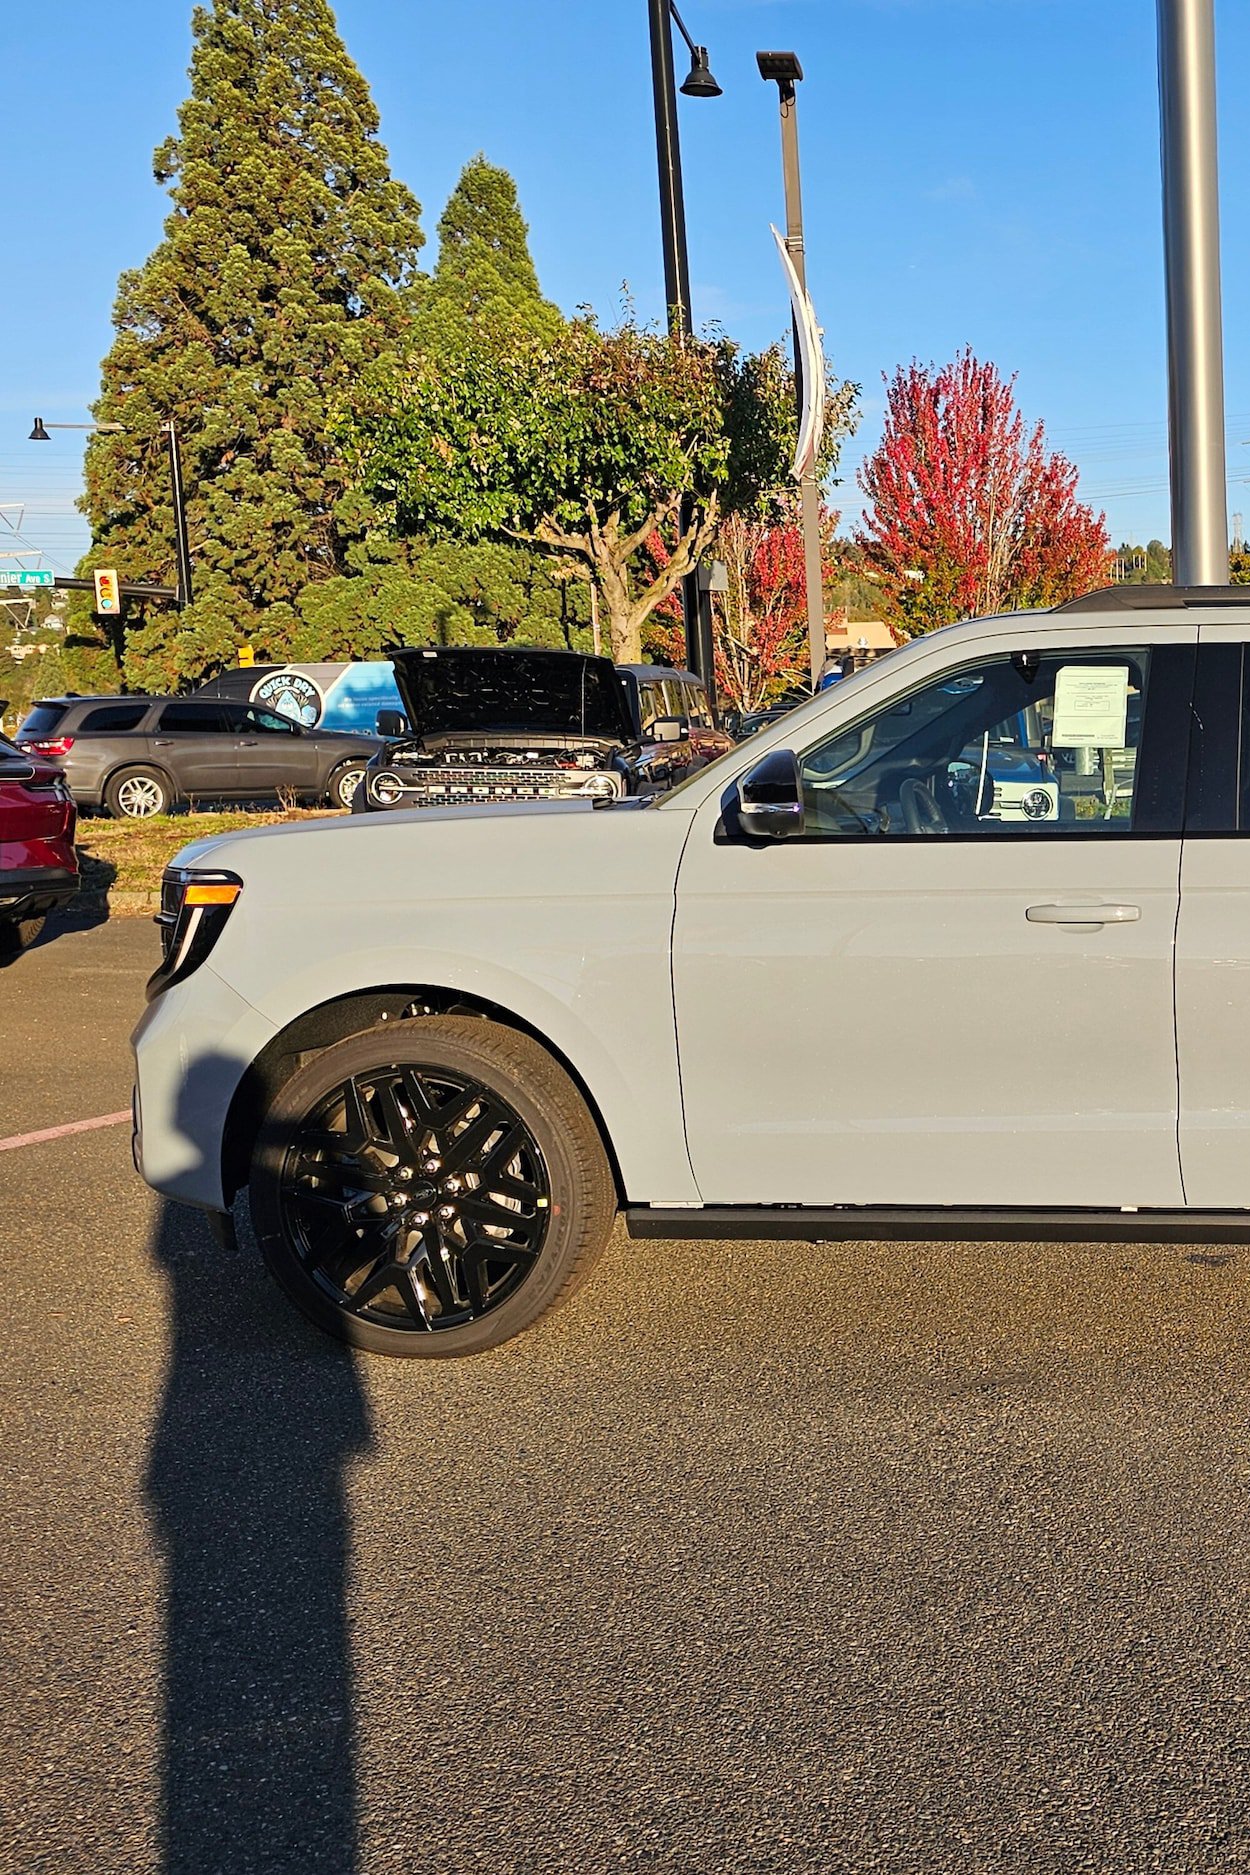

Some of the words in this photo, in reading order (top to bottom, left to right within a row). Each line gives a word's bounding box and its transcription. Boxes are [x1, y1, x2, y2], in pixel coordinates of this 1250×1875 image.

[25, 574, 41, 584] Ave
[43, 573, 50, 583] S
[259, 675, 291, 699] QUICK
[294, 676, 316, 697] DRY
[428, 785, 556, 796] BRONCO
